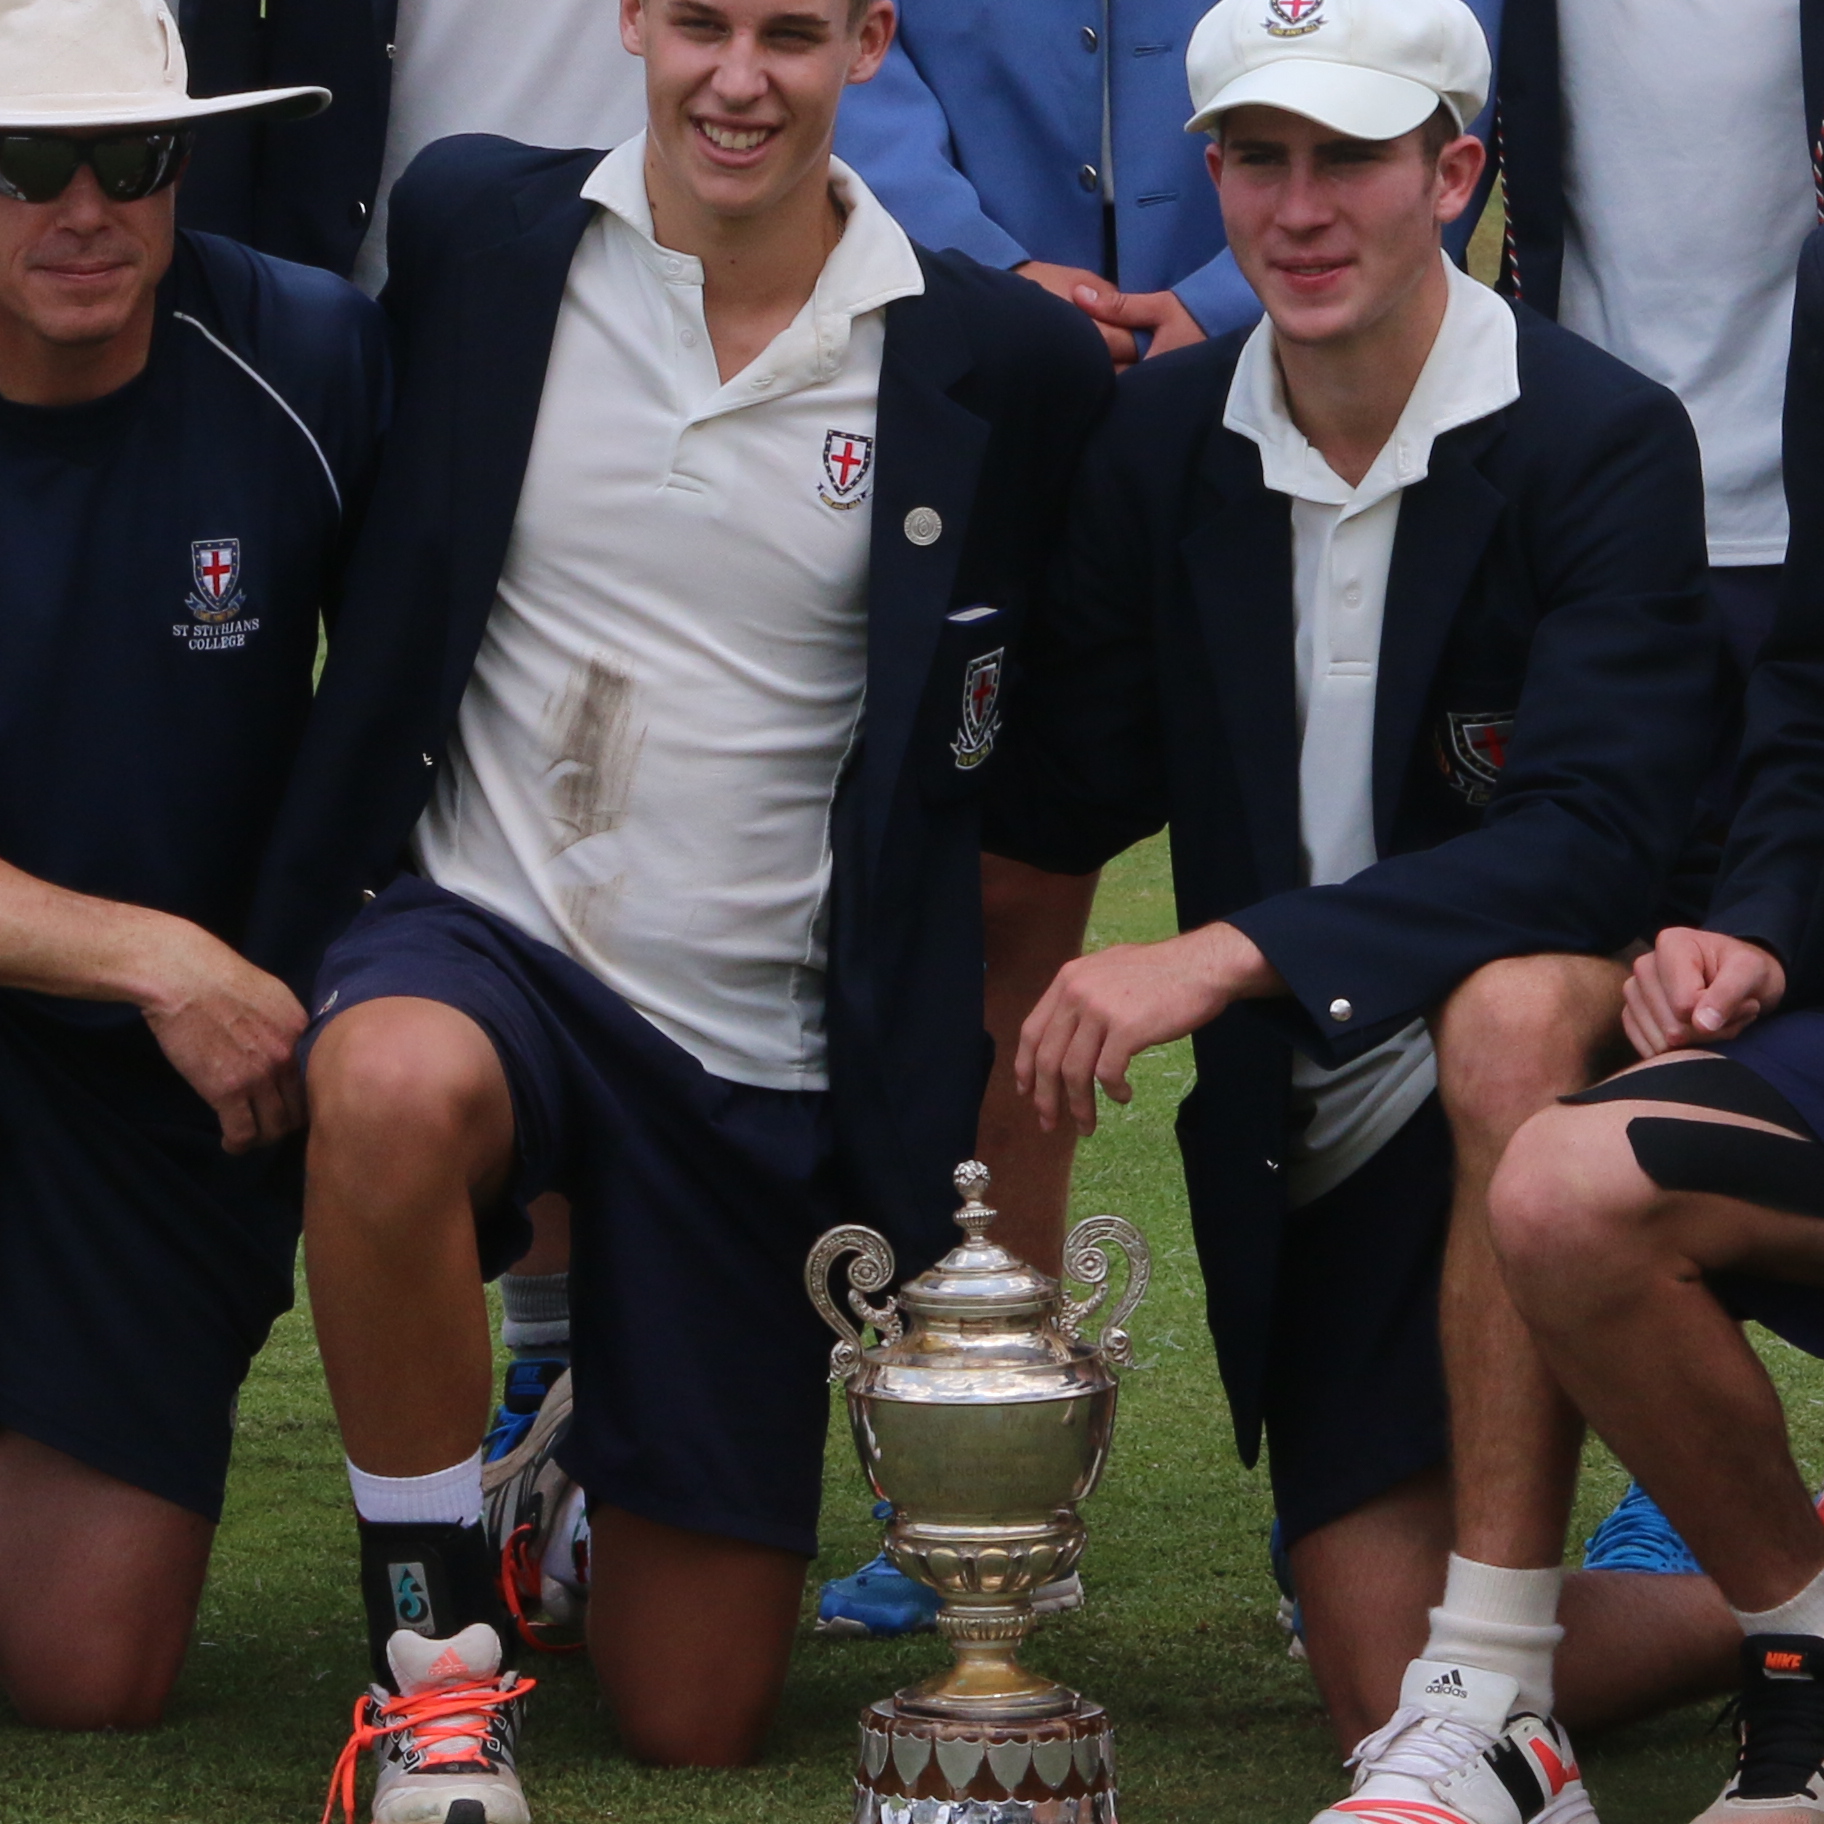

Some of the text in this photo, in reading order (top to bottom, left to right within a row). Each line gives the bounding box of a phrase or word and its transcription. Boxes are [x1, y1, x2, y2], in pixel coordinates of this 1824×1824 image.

[172, 623, 190, 637] ST
[188, 633, 245, 651] COLLEGE
[1765, 1651, 1804, 1672] NIKE
[1425, 1682, 1468, 1699] adidas
